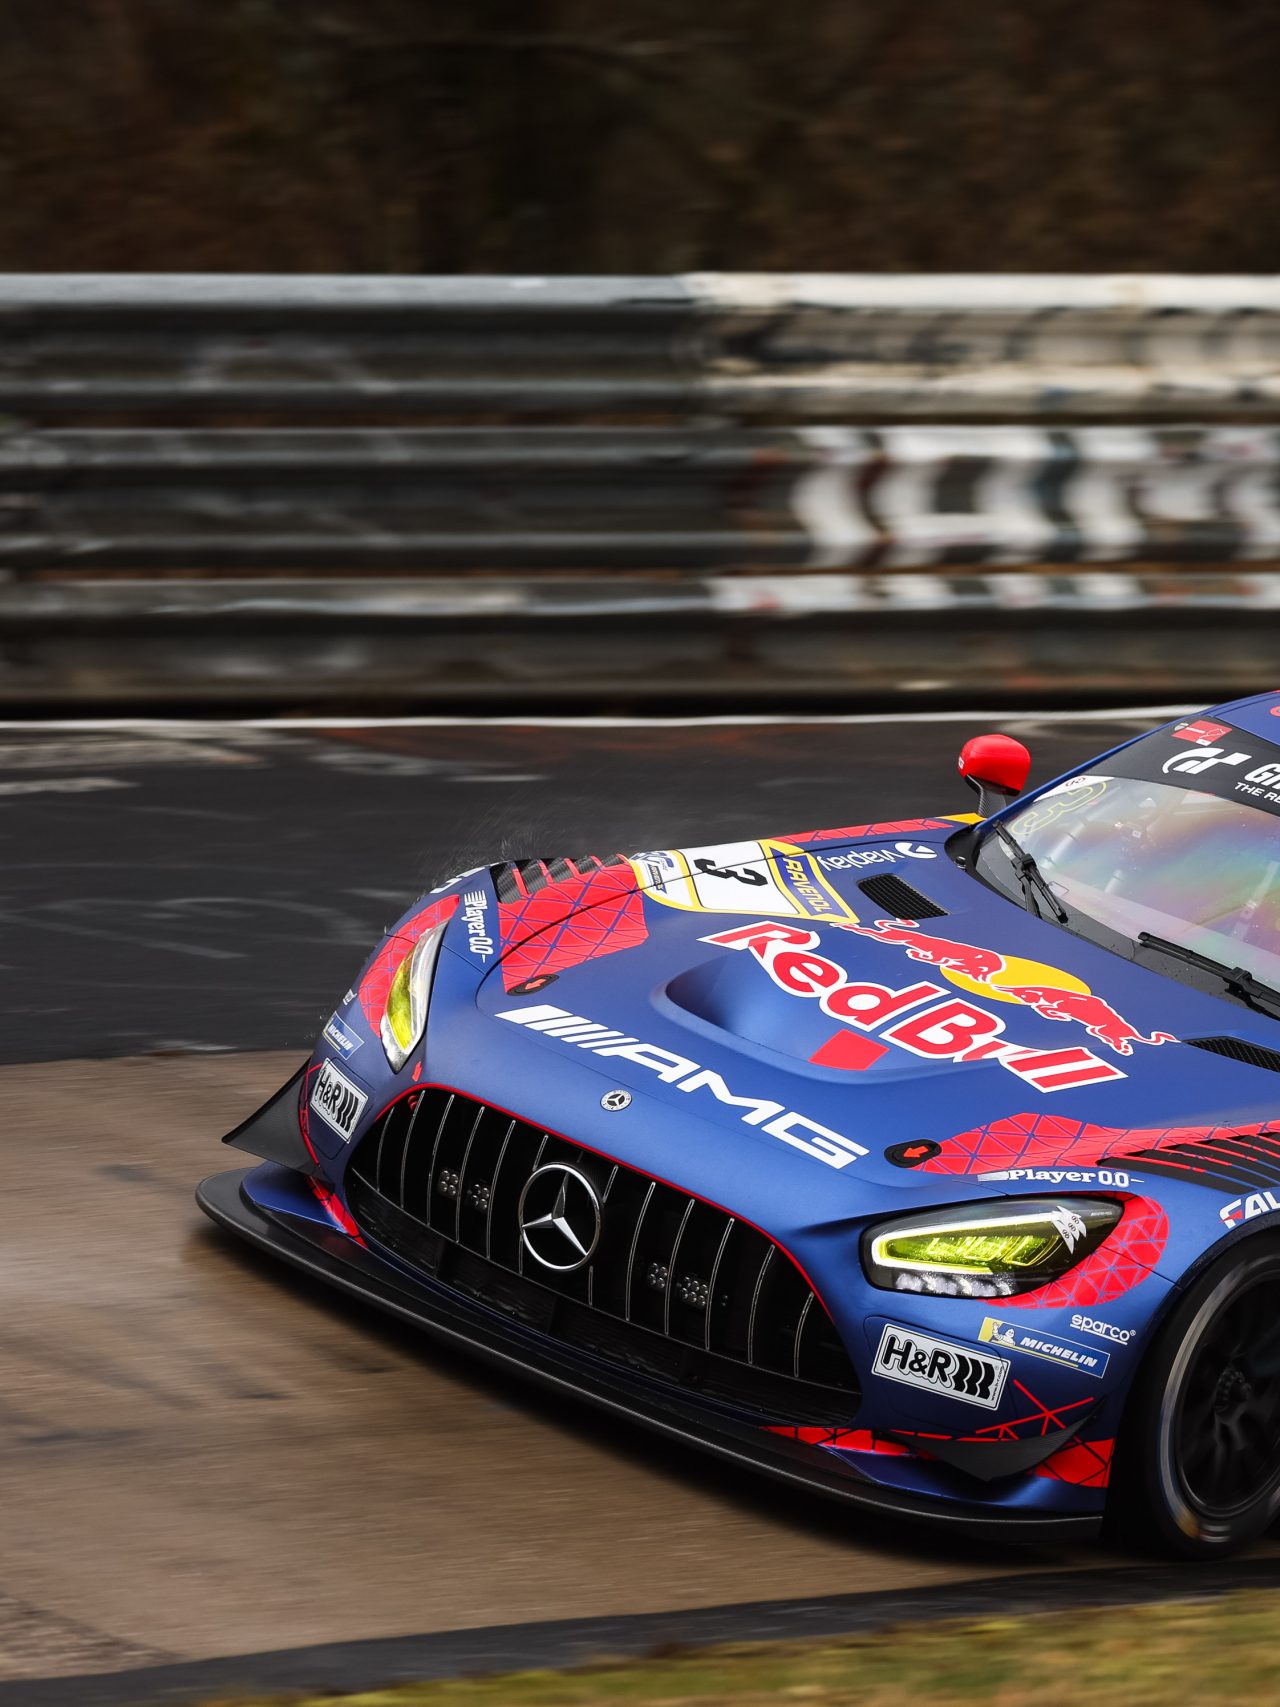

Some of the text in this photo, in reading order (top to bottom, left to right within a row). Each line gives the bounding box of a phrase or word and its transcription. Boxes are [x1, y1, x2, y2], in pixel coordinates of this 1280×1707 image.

[1235, 781, 1263, 797] THE
[694, 858, 769, 886] 3
[816, 849, 905, 871] viaplay
[783, 857, 833, 913] RAVENOL
[697, 920, 951, 1031] Red
[315, 1066, 344, 1120] H&R
[592, 1038, 870, 1170] AMG
[1006, 1168, 1130, 1188] Player 0.0
[1071, 1314, 1131, 1342] sparco
[883, 1334, 952, 1385] H&R
[1019, 1336, 1099, 1368] MICHELIN
